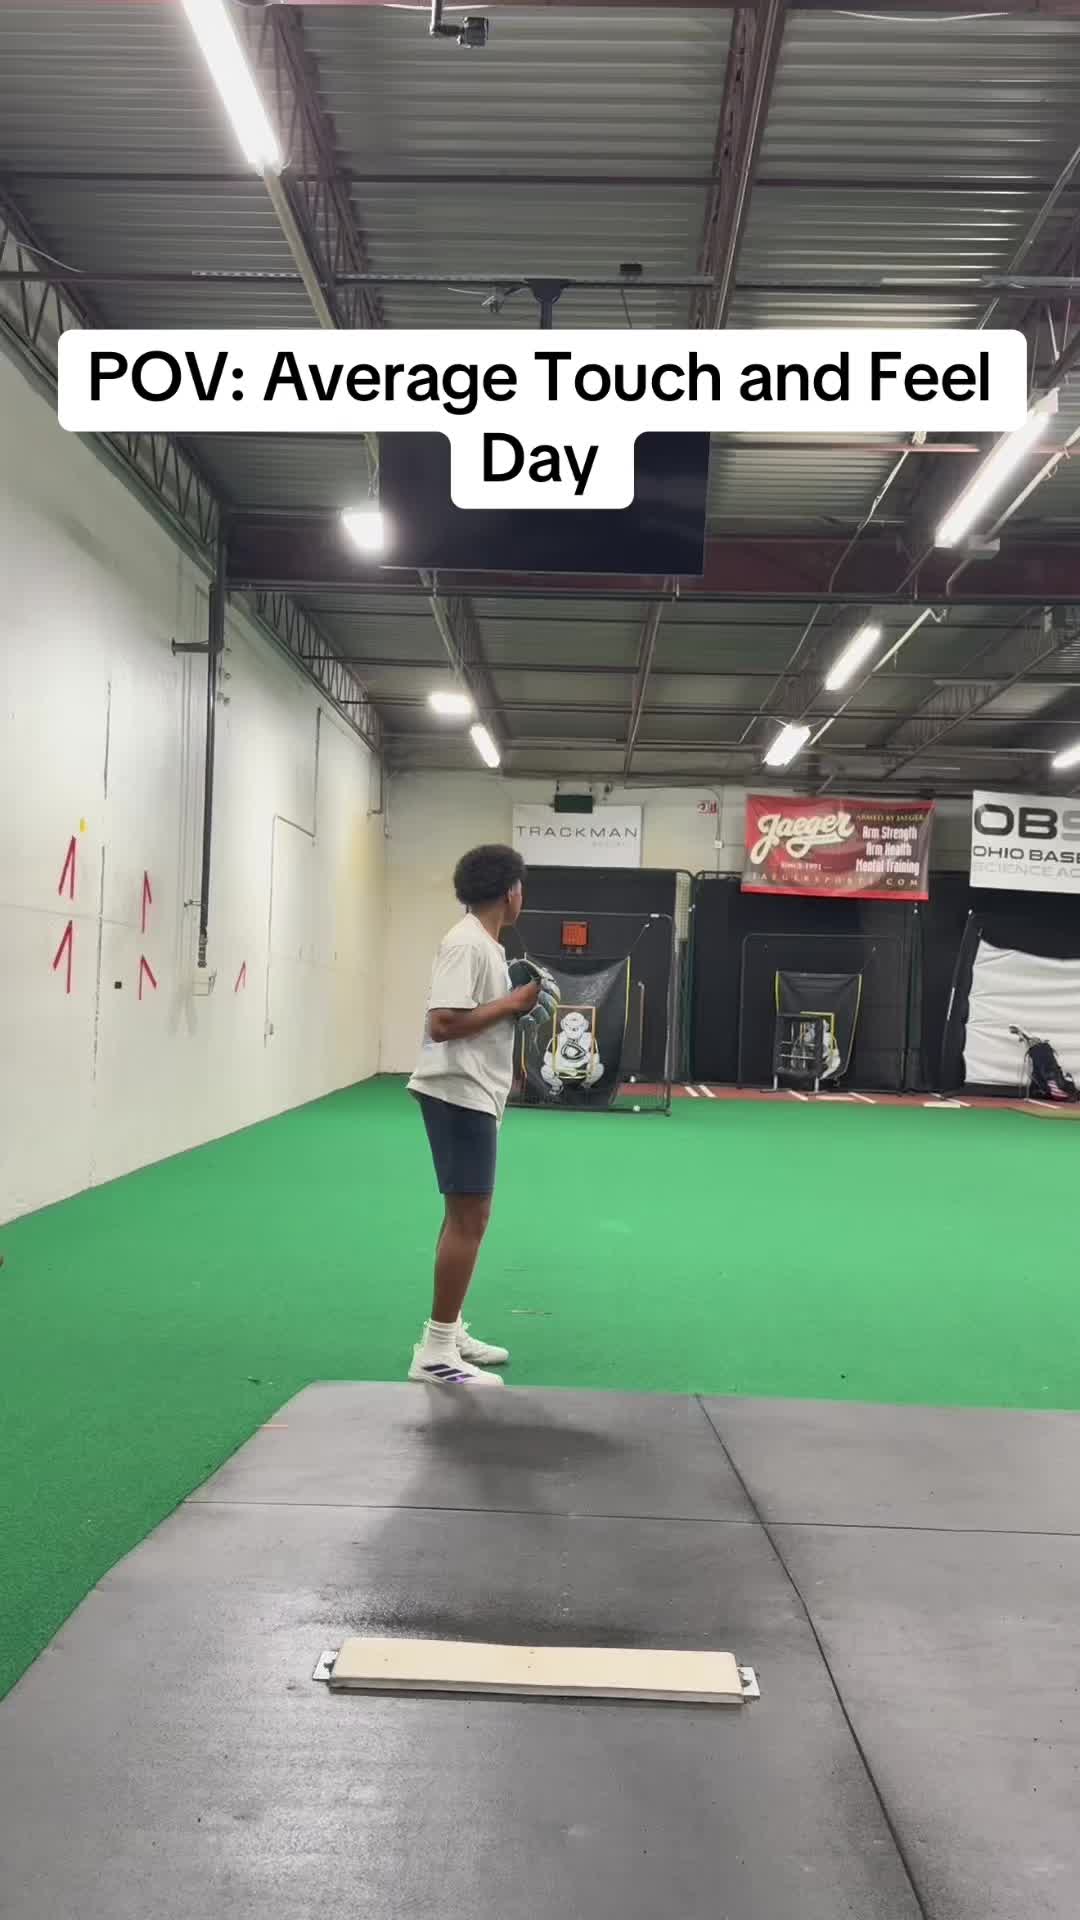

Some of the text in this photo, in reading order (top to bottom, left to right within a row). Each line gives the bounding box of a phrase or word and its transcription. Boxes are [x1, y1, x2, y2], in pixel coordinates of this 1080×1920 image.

[515, 825, 637, 838] TRACKMAN
[750, 811, 855, 864] Jaeger
[862, 825, 918, 841] Arm Strength
[866, 842, 912, 857] Arm Health
[973, 845, 1025, 860] OHIO
[855, 858, 920, 876] Mental Training
